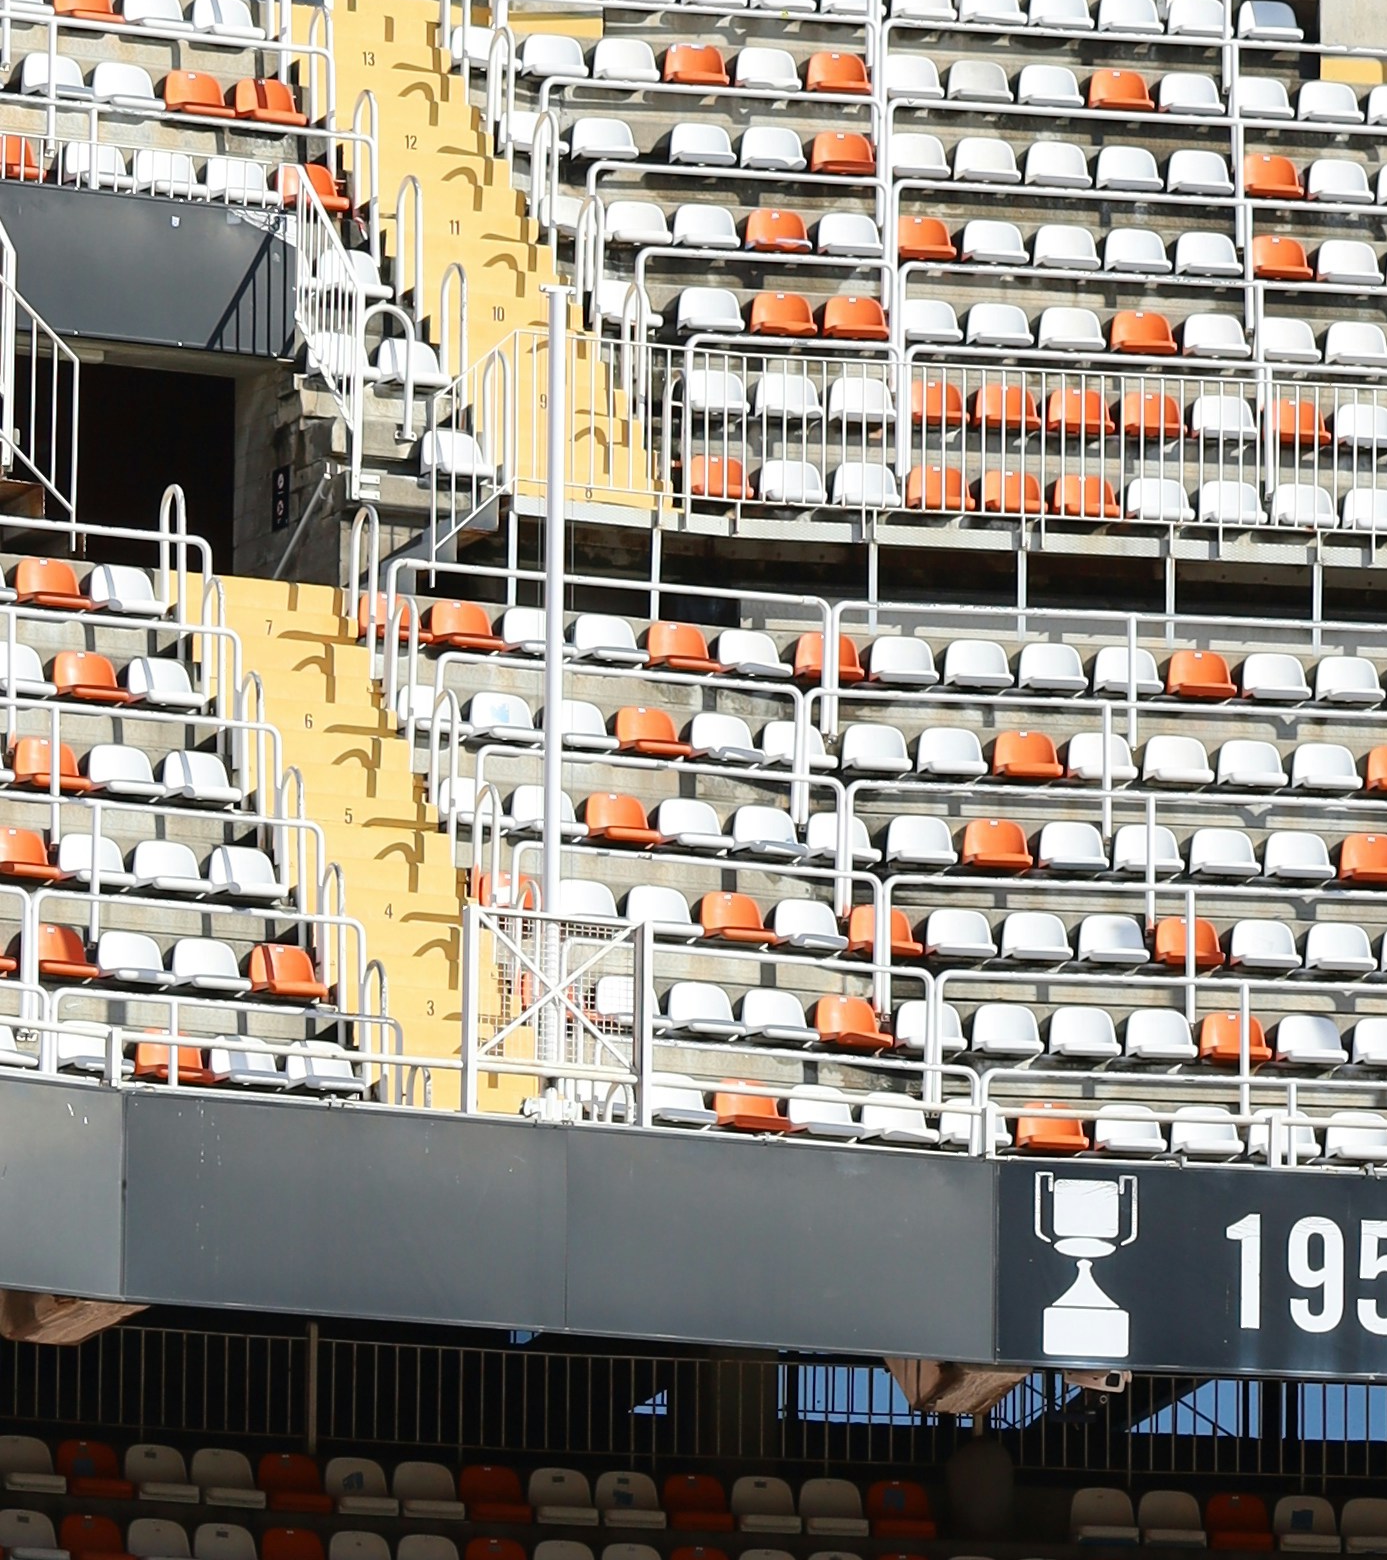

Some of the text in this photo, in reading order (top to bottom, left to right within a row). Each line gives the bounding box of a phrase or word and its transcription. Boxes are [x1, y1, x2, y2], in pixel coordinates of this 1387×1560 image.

[362, 52, 375, 67] 13
[405, 135, 418, 150] 12
[449, 219, 460, 235] 11
[492, 306, 505, 322] 10
[540, 393, 547, 409] 9
[264, 620, 273, 635] 7
[304, 713, 313, 729] 6
[345, 808, 353, 824] 5
[384, 903, 394, 919] 4
[426, 1000, 435, 1016] 3
